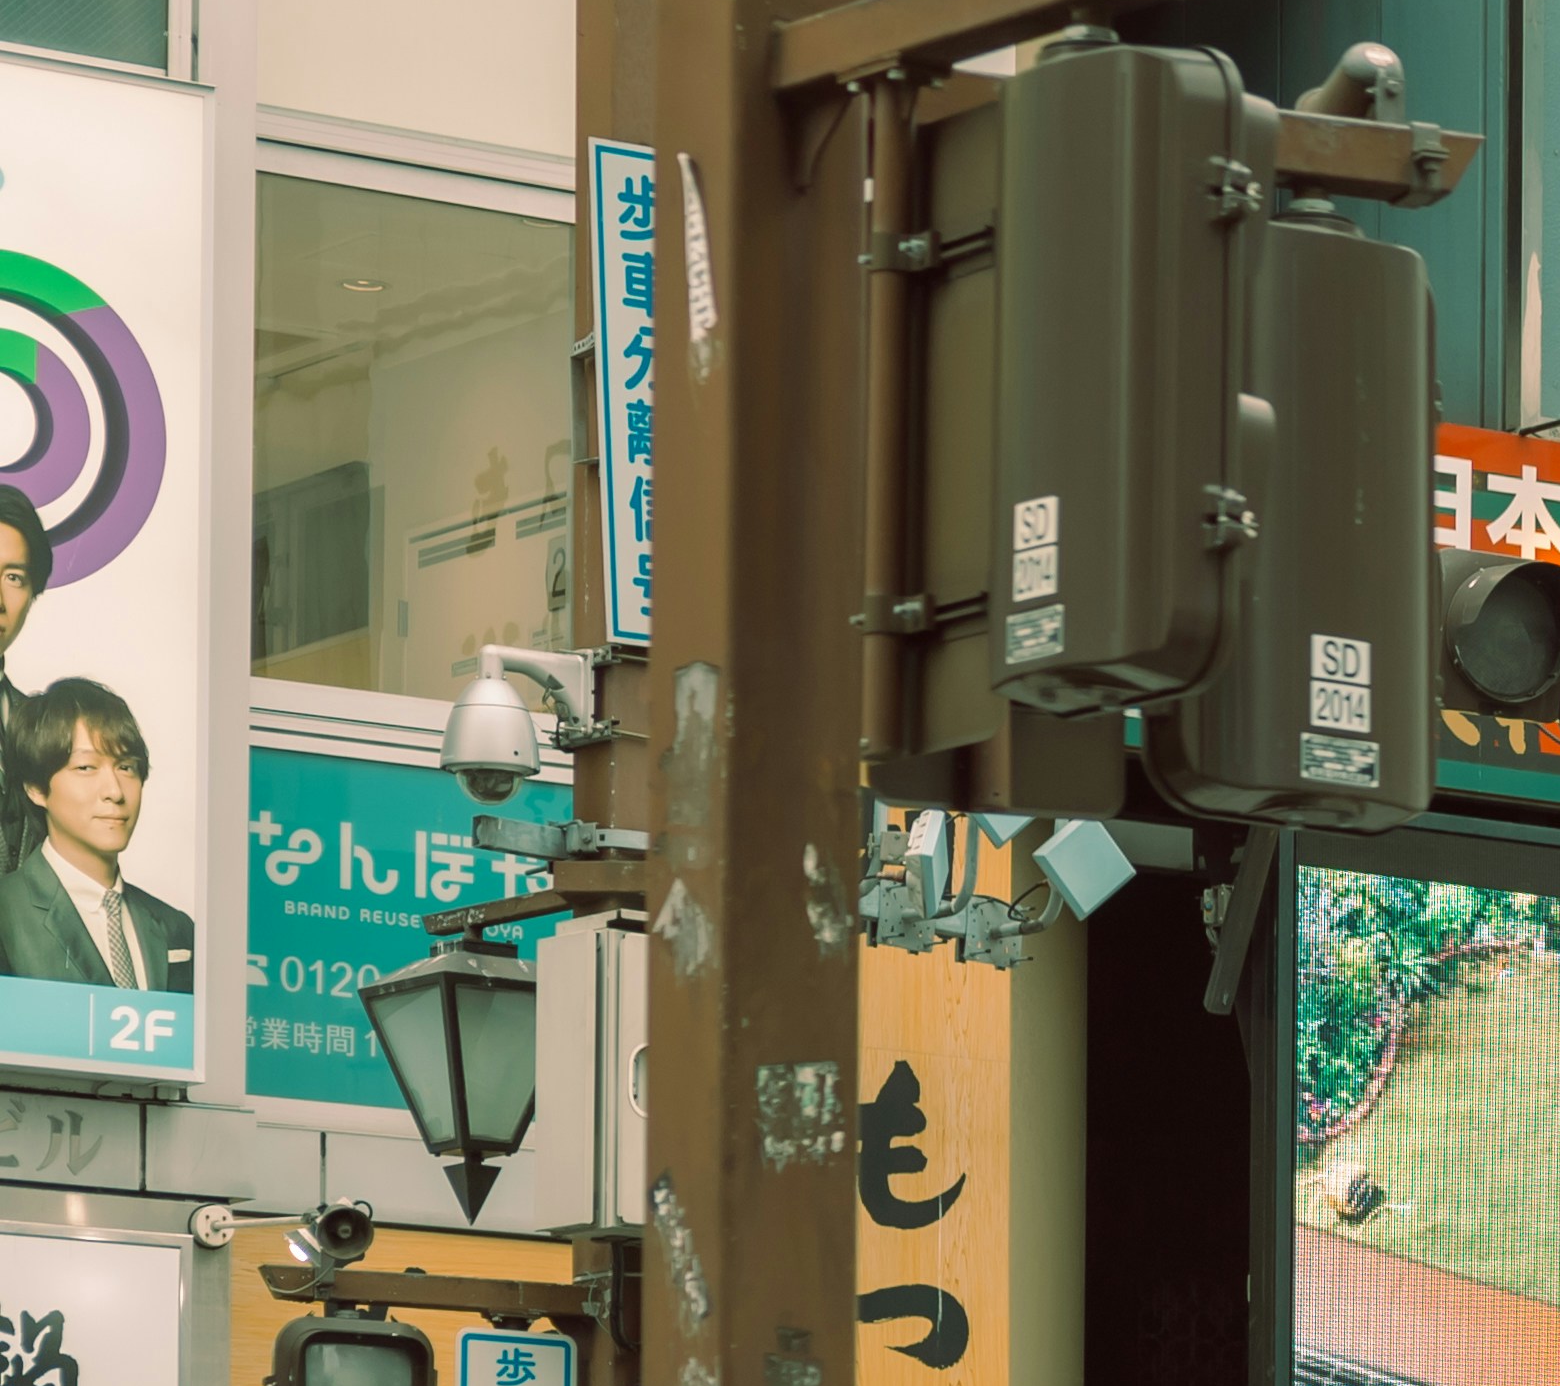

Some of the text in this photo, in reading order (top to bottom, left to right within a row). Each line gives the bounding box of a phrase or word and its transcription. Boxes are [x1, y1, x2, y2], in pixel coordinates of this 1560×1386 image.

[1321, 640, 1361, 677] SD
[1314, 688, 1365, 728] 2014
[284, 899, 350, 921] BRAND
[359, 908, 421, 929] REUSE
[109, 1005, 177, 1052] 2F
